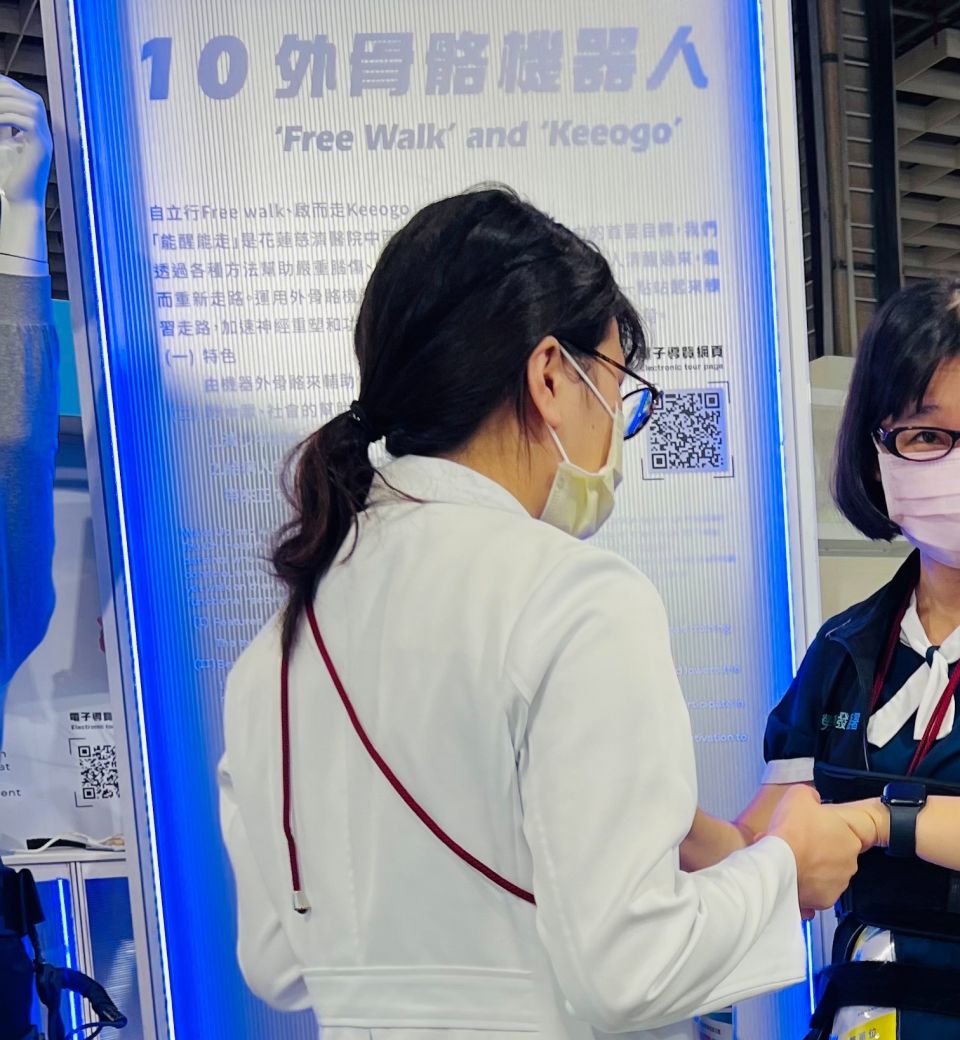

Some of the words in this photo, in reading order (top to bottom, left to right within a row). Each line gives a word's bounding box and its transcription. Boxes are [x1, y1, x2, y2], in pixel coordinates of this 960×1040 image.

[274, 25, 709, 98] 外骨骼機器人
[466, 120, 528, 148] and
[203, 347, 237, 364] 特色
